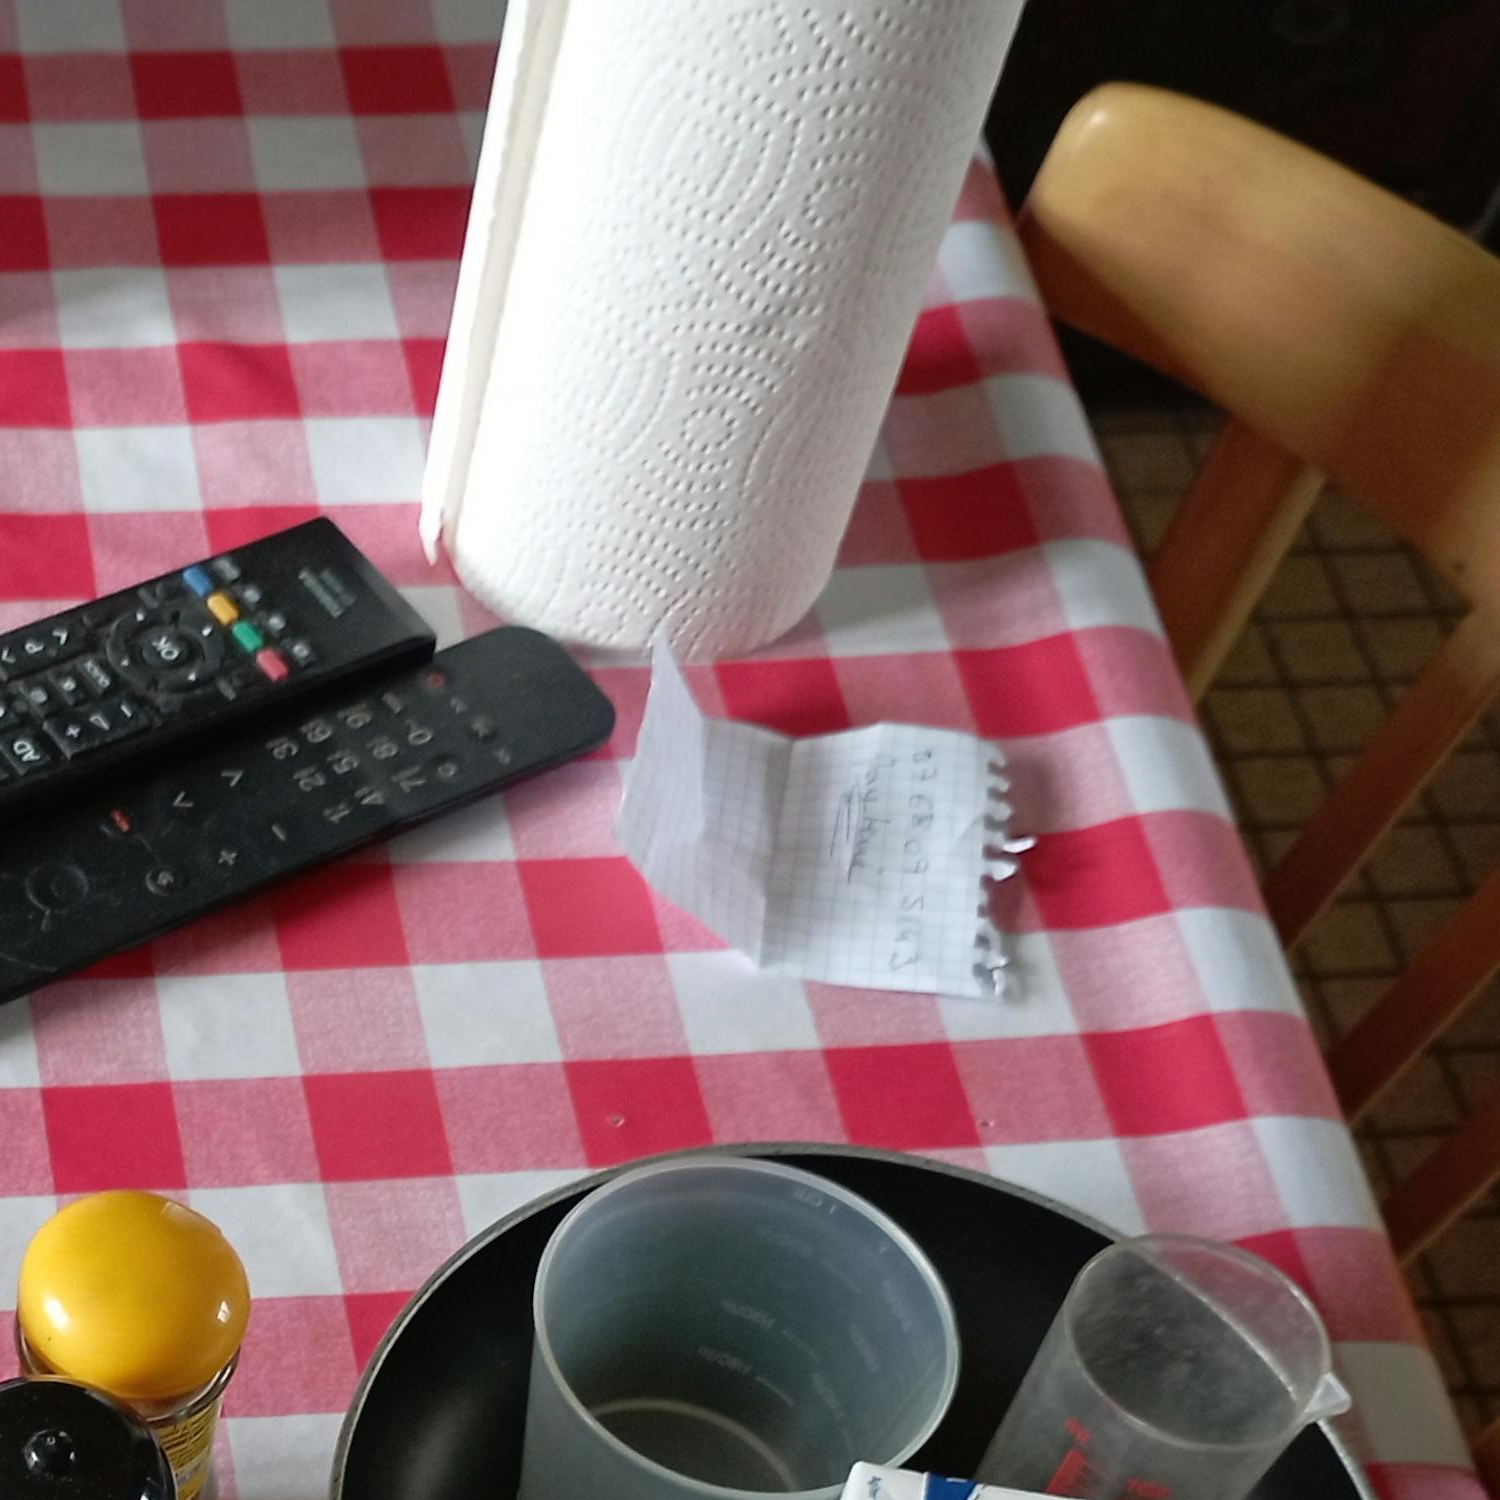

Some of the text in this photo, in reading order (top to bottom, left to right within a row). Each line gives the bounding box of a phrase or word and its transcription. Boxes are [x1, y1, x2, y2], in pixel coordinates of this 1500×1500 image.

[24, 638, 44, 654] P
[153, 635, 179, 661] OK
[13, 740, 40, 762] AD
